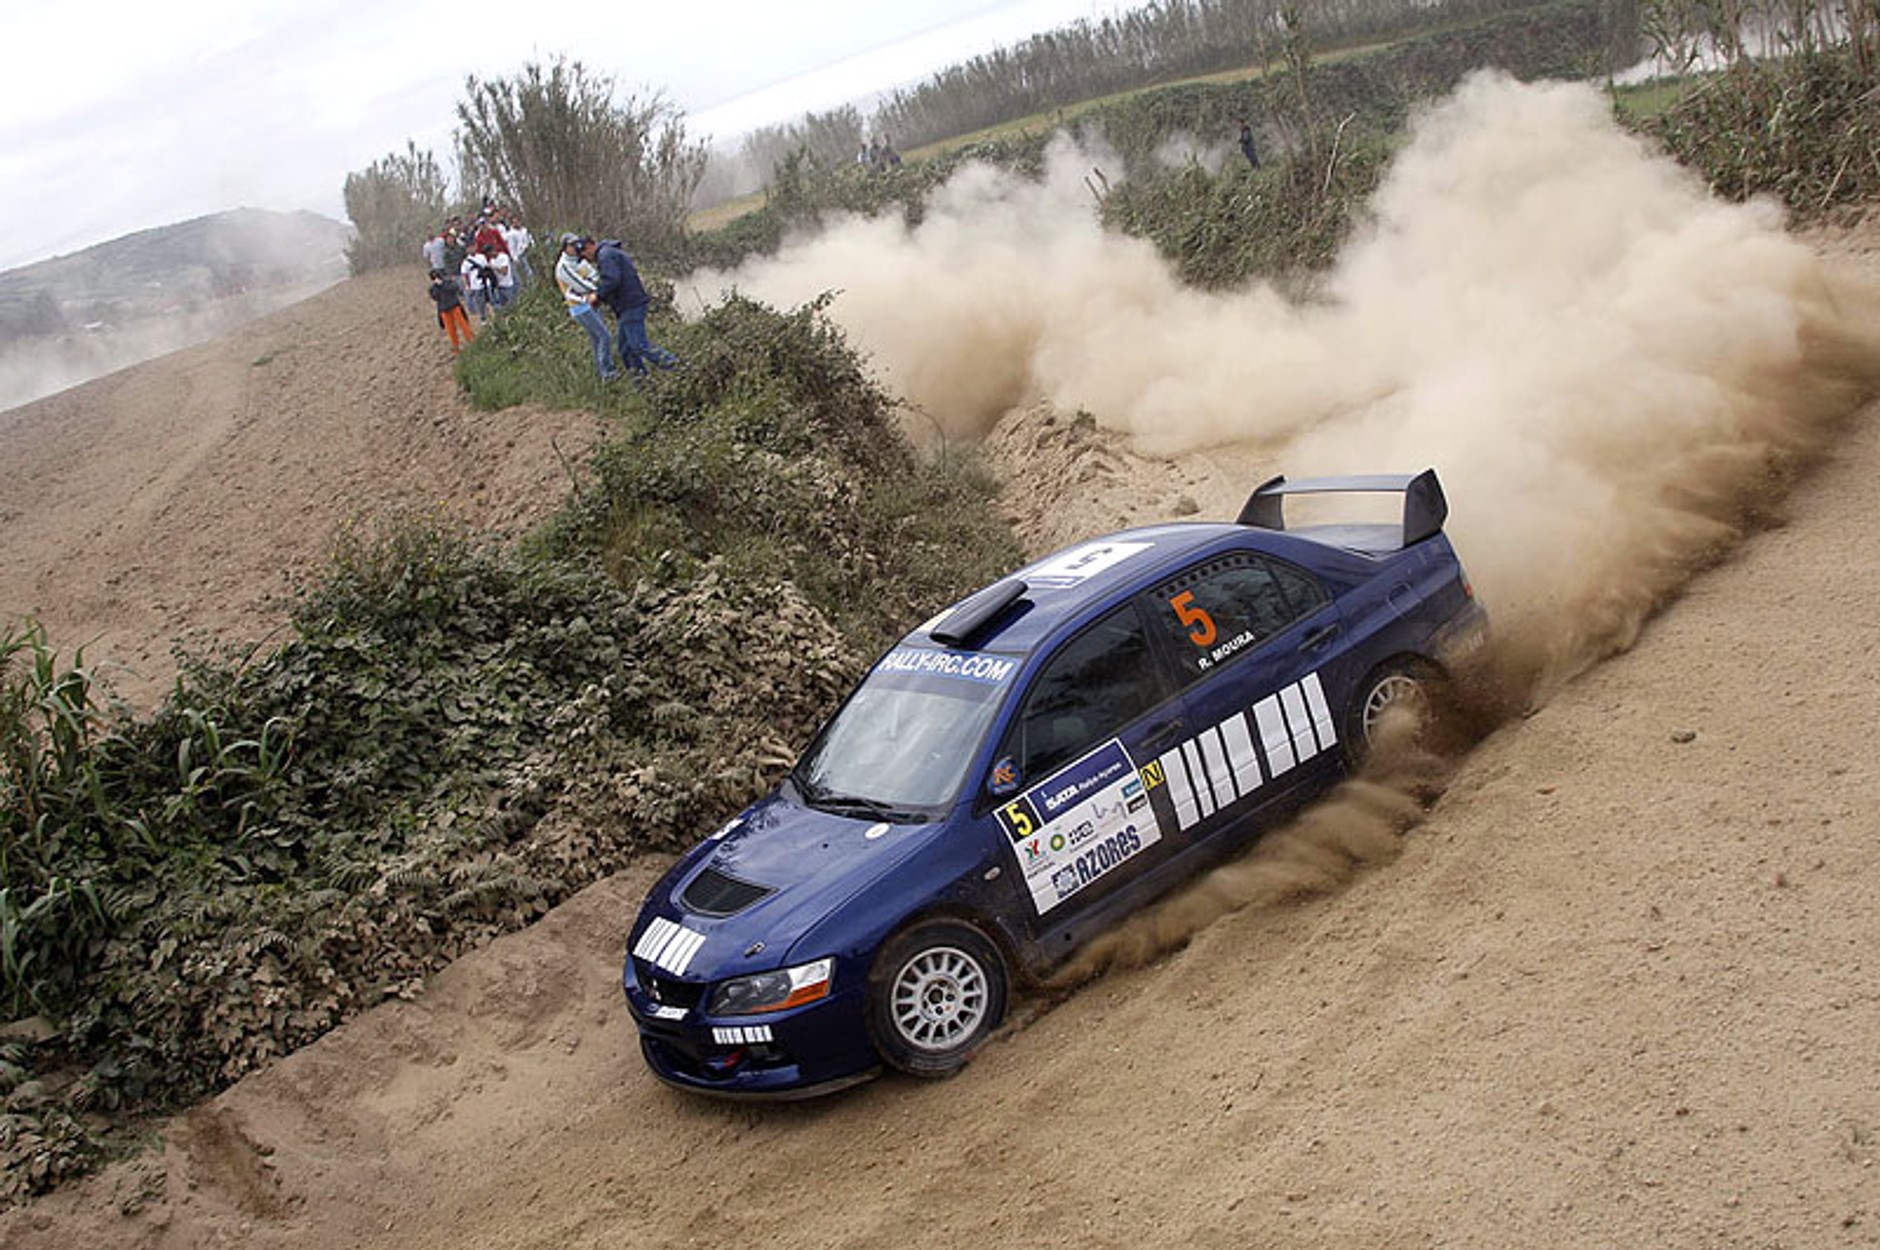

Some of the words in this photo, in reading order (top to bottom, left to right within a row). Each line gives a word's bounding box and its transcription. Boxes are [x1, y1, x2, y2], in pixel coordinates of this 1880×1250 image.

[1169, 590, 1217, 646] 5
[879, 651, 1014, 681] RALLY-IRC.COM
[1198, 657, 1214, 671] R.
[1211, 630, 1255, 662] MOURA
[1006, 803, 1033, 836] 5
